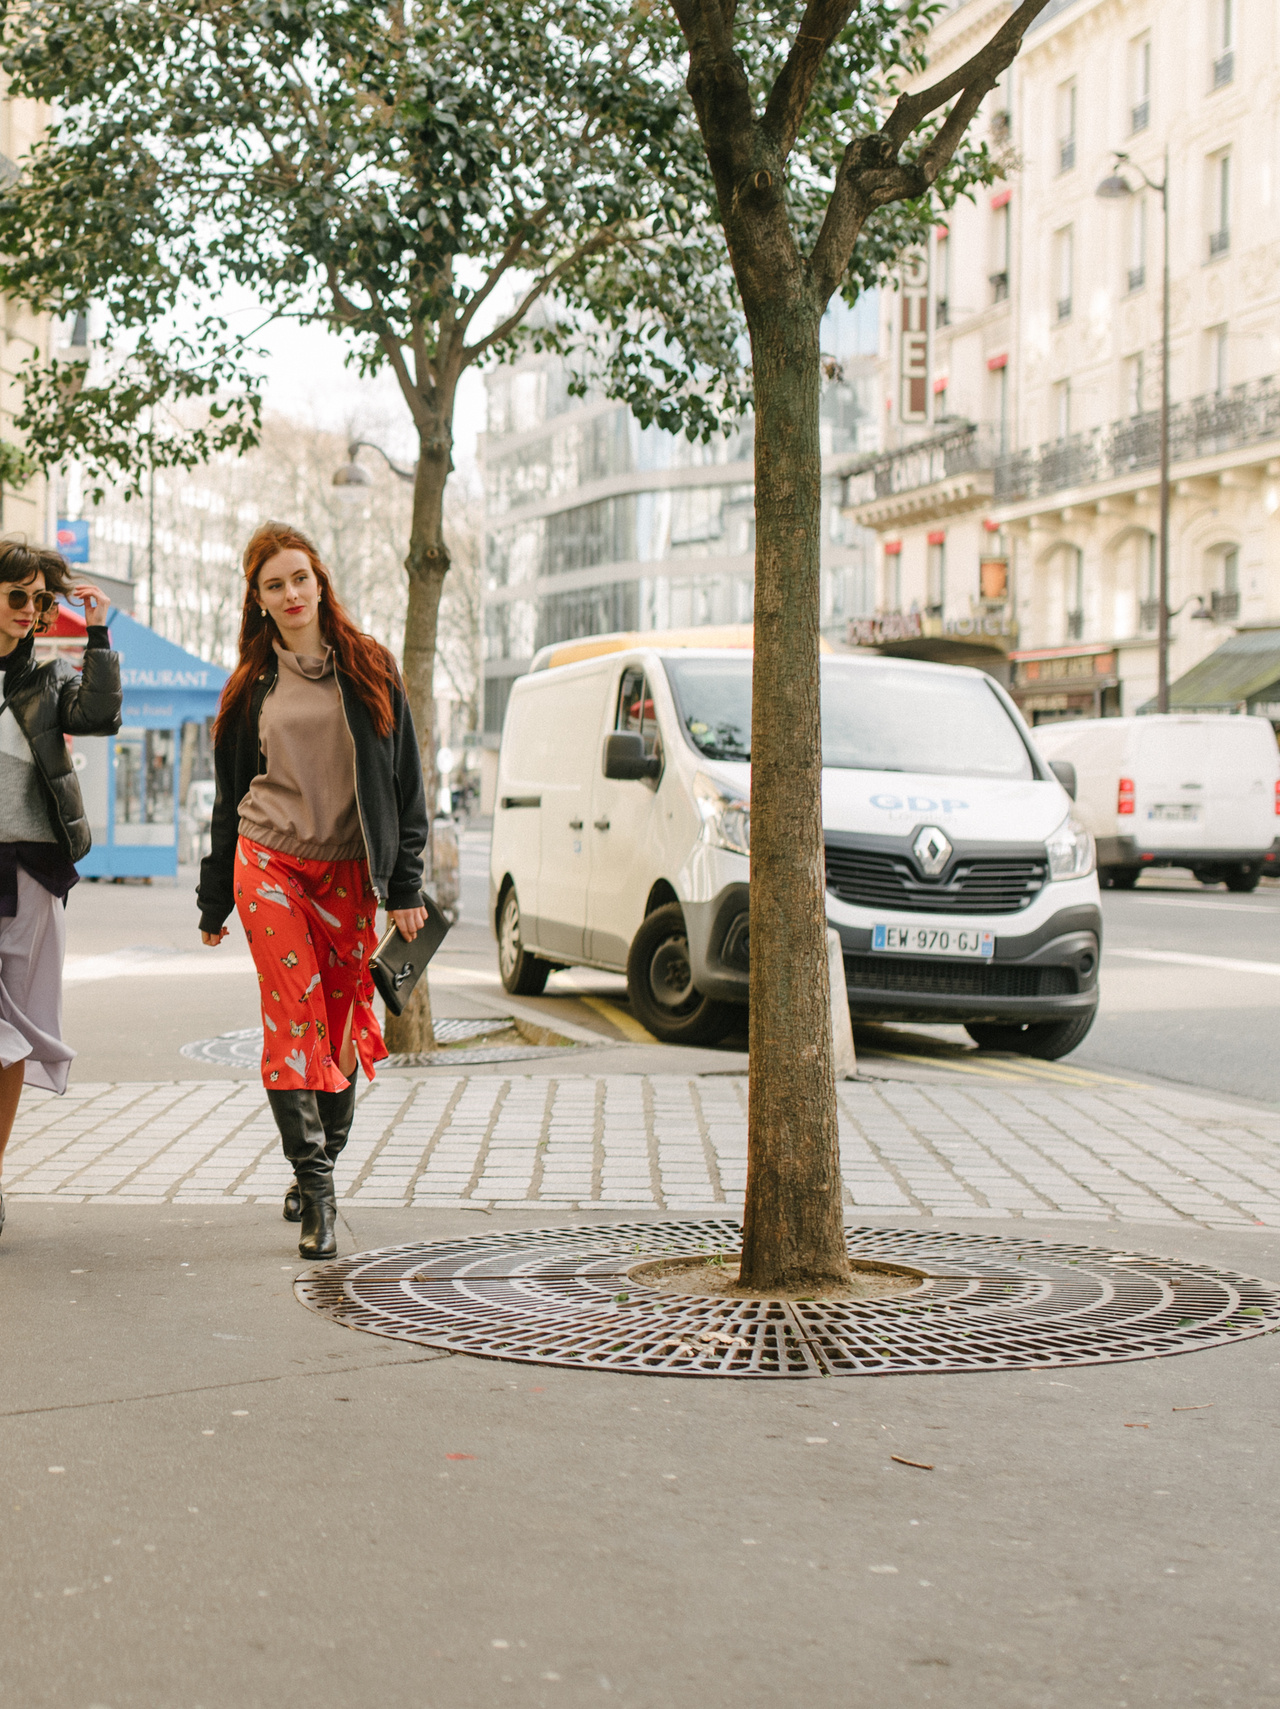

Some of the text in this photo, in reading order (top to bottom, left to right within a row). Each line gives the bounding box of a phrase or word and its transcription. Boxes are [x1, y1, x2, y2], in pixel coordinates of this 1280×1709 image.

[900, 243, 927, 422] OTEL
[121, 669, 209, 687] STAURANT
[869, 794, 970, 813] GDP
